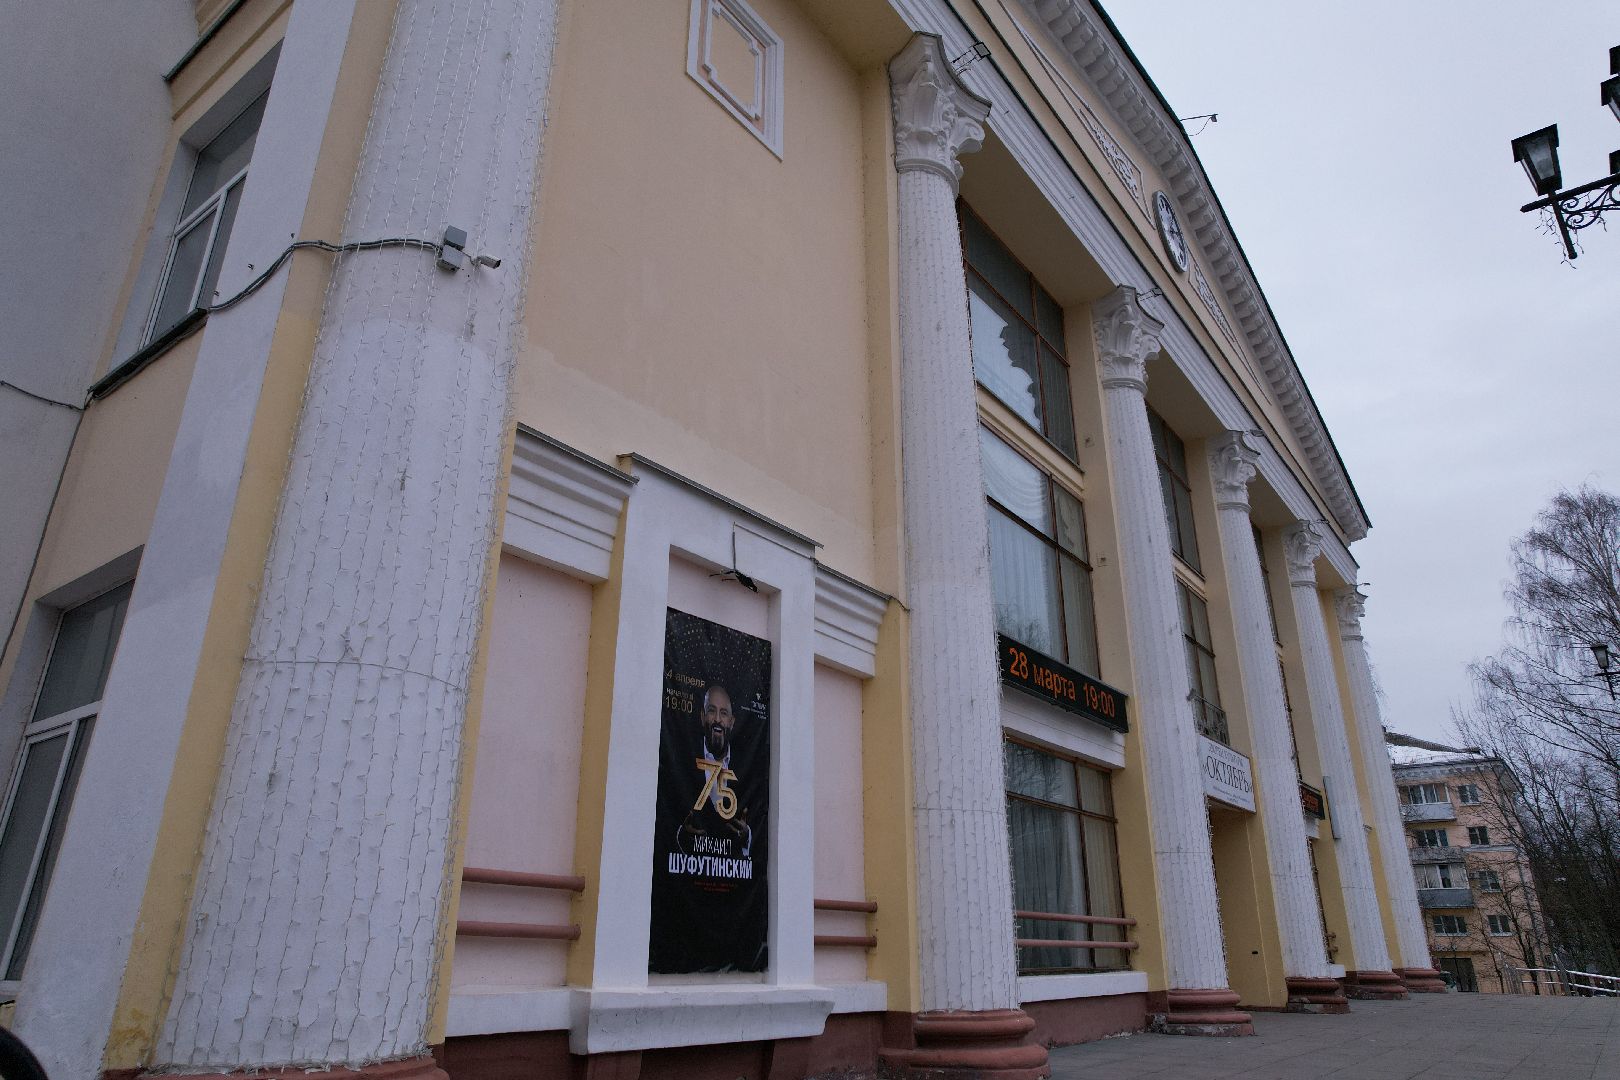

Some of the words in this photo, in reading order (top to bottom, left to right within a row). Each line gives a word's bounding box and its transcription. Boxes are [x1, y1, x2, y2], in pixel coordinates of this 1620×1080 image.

[676, 673, 706, 688] апреля
[1008, 647, 1029, 680] 28
[1032, 663, 1076, 702] марта
[1083, 682, 1115, 719] 19:00
[665, 696, 693, 713] 19:00
[693, 757, 738, 820] 75
[693, 834, 733, 855] МИХАИЛ
[668, 852, 753, 880] ШУФУТИНСКИЙ
